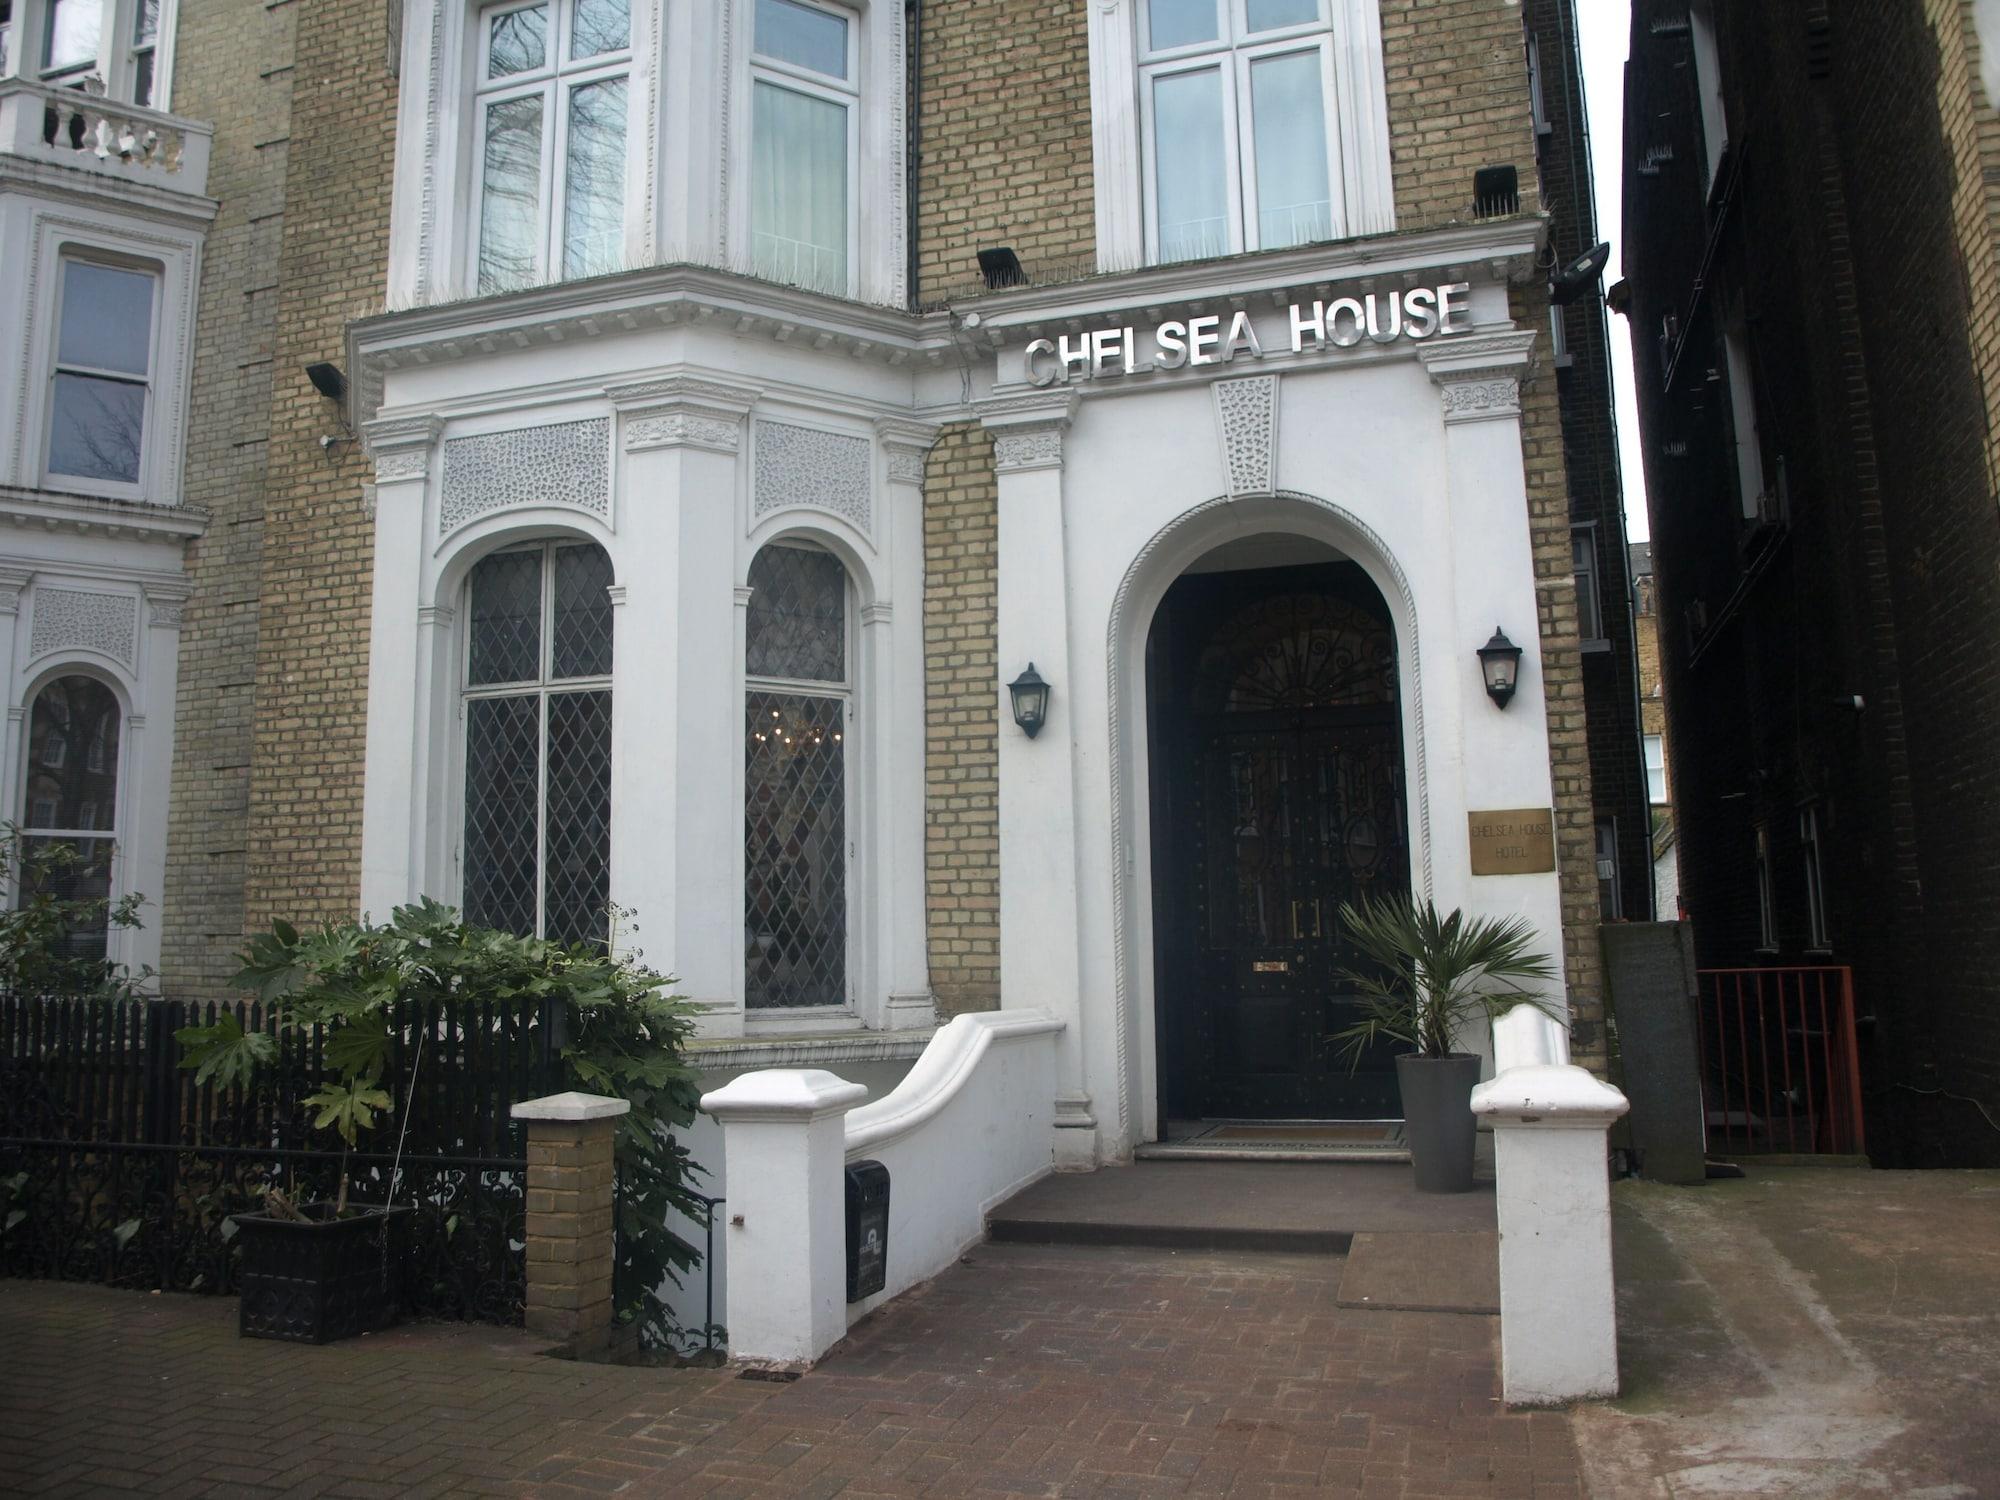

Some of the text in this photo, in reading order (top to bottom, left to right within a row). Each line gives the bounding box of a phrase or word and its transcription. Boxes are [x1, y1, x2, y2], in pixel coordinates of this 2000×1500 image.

[1025, 282, 1475, 386] CHELSEA HOUSE
[1471, 823, 1550, 837] CHELSEA HOUSE
[1496, 847, 1528, 858] HOTEL
